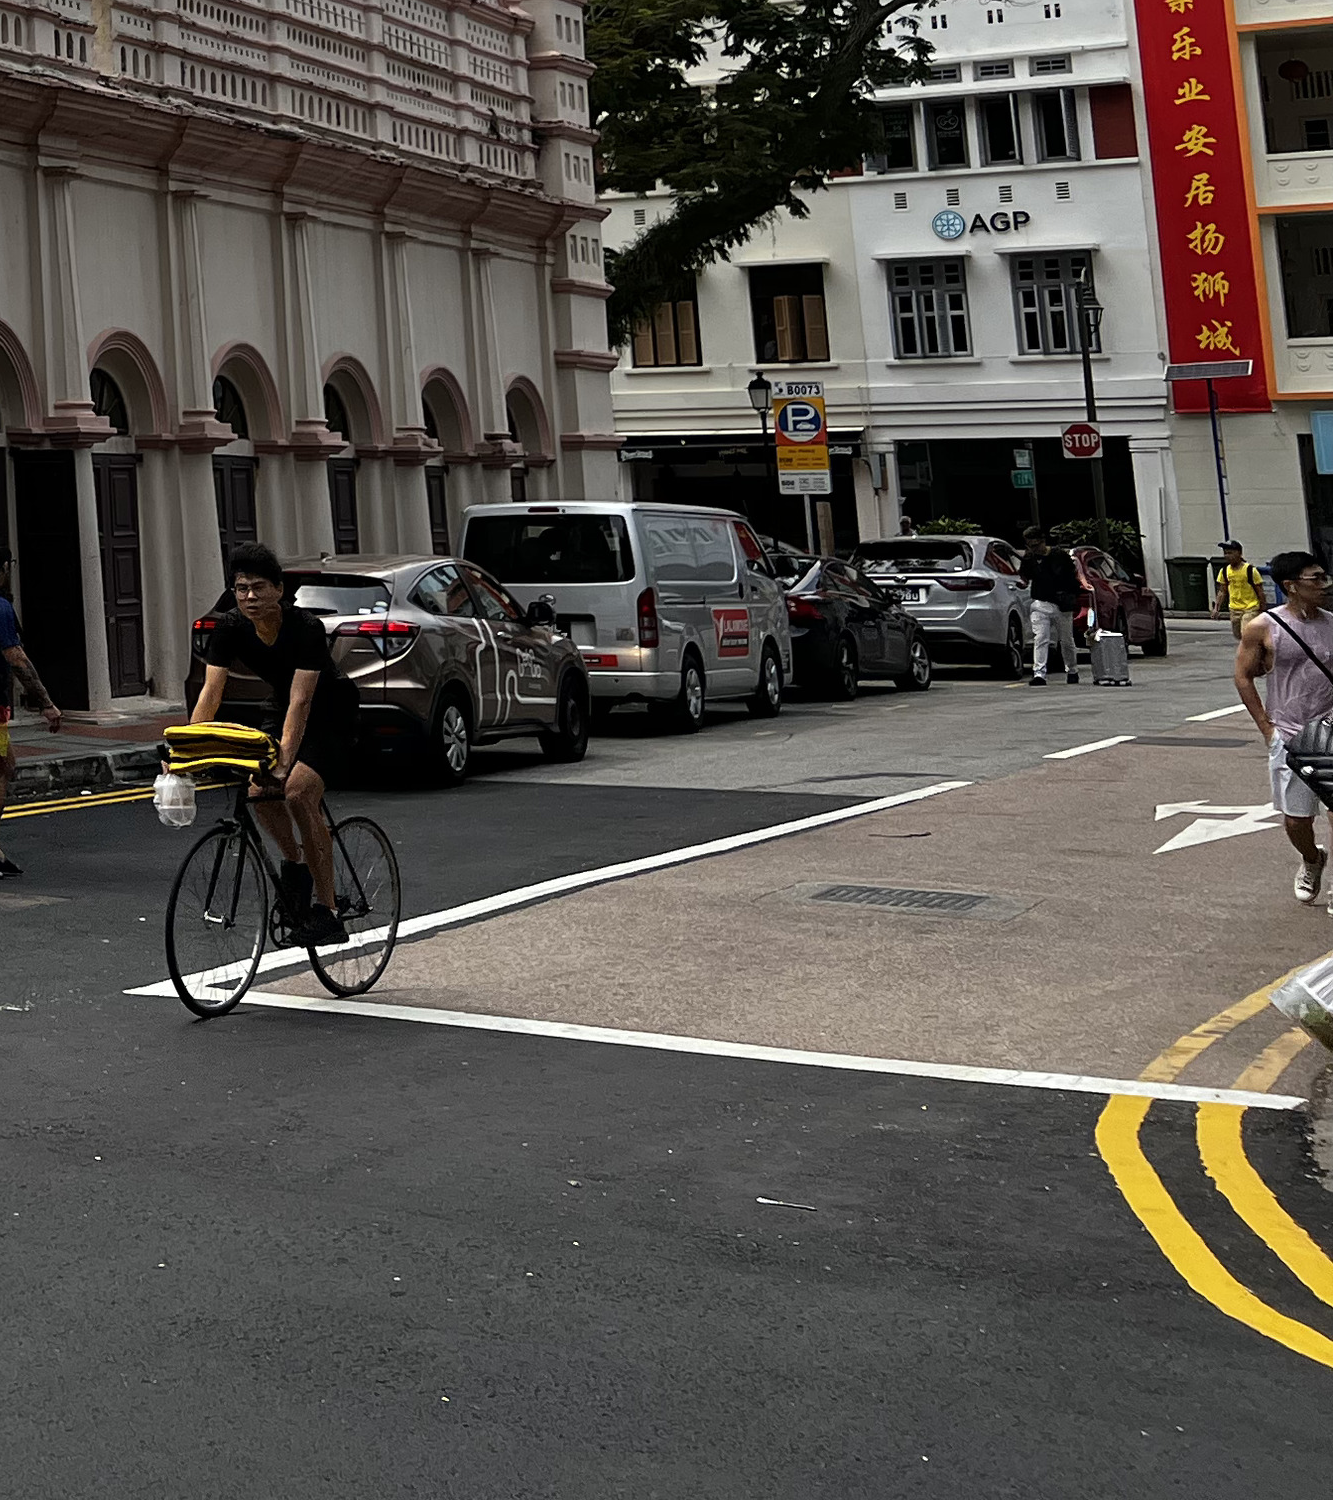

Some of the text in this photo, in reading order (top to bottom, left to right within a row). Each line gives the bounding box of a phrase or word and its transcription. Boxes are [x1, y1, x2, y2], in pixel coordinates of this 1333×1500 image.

[969, 211, 1031, 234] AGP
[787, 385, 821, 396] B0073
[1064, 433, 1100, 448] STOP
